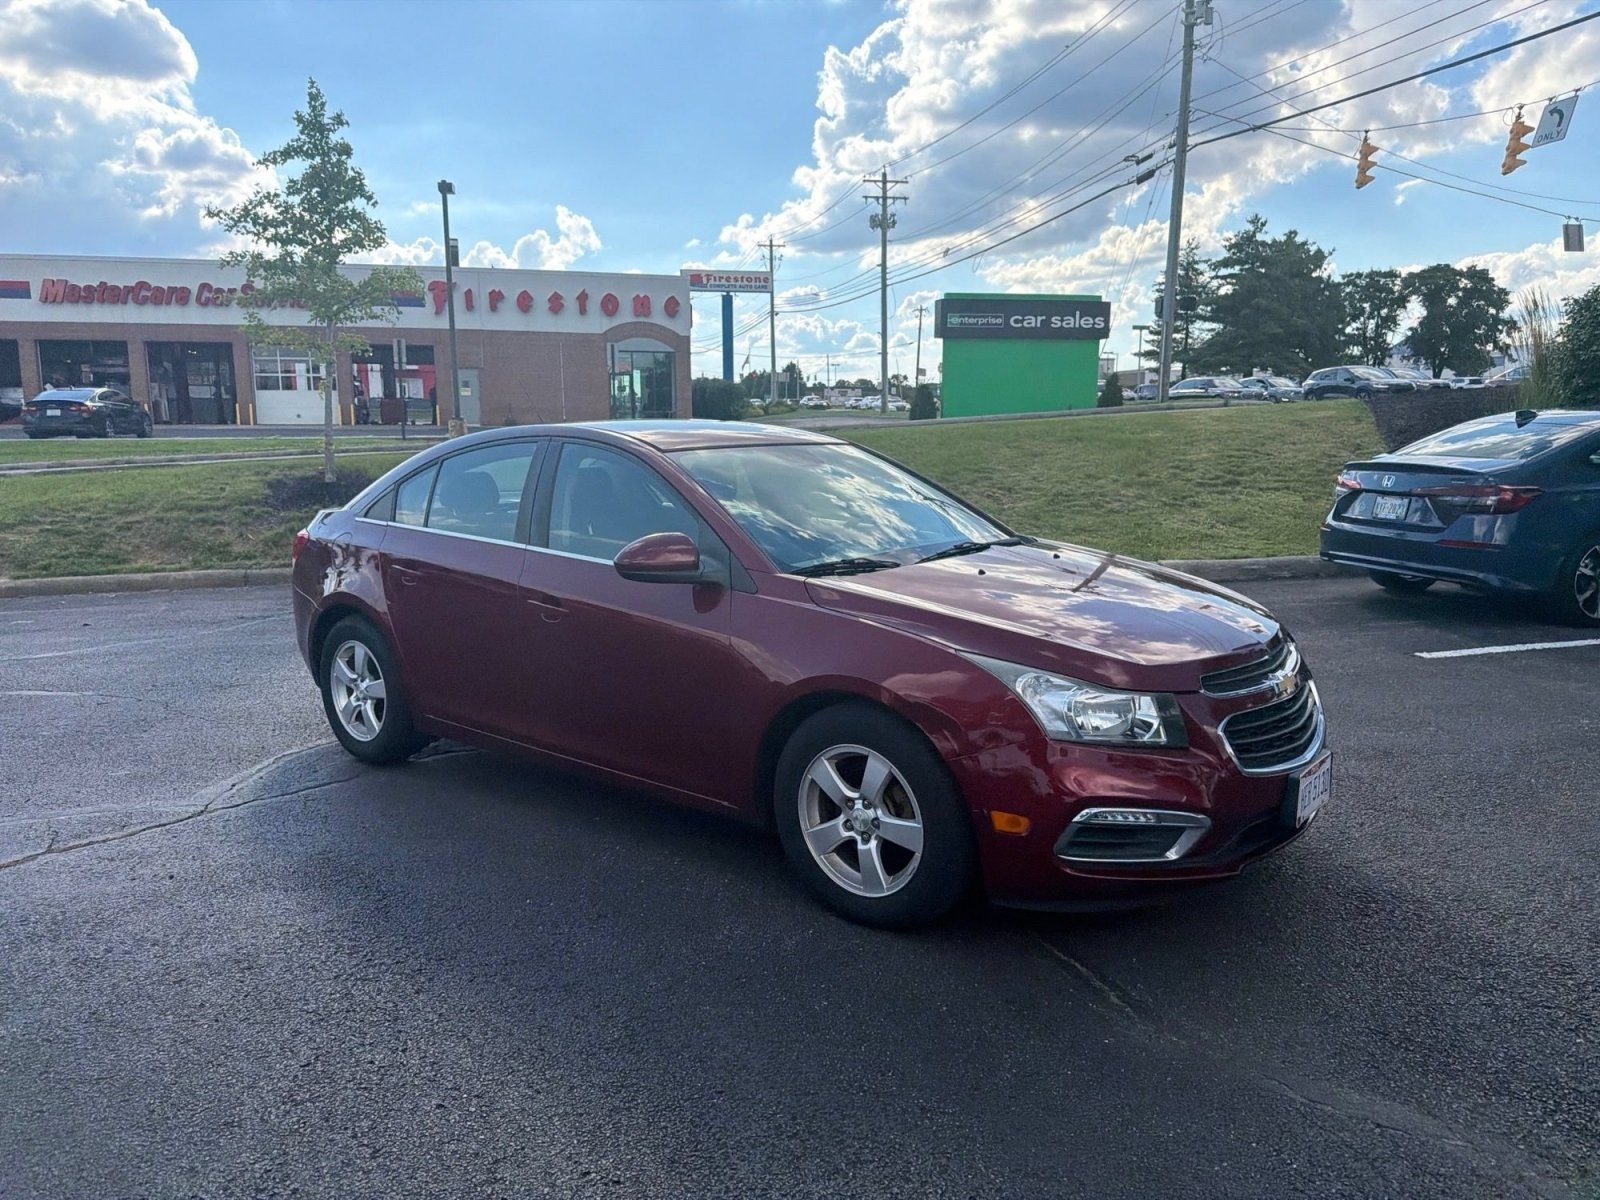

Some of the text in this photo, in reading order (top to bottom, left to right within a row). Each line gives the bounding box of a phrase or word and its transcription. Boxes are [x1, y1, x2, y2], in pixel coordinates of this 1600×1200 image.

[1537, 129, 1562, 143] ONLY
[704, 273, 769, 284] Firestone
[39, 278, 191, 305] MasterCare
[427, 280, 680, 318] Firestone
[949, 310, 1105, 329] enterprise car sales
